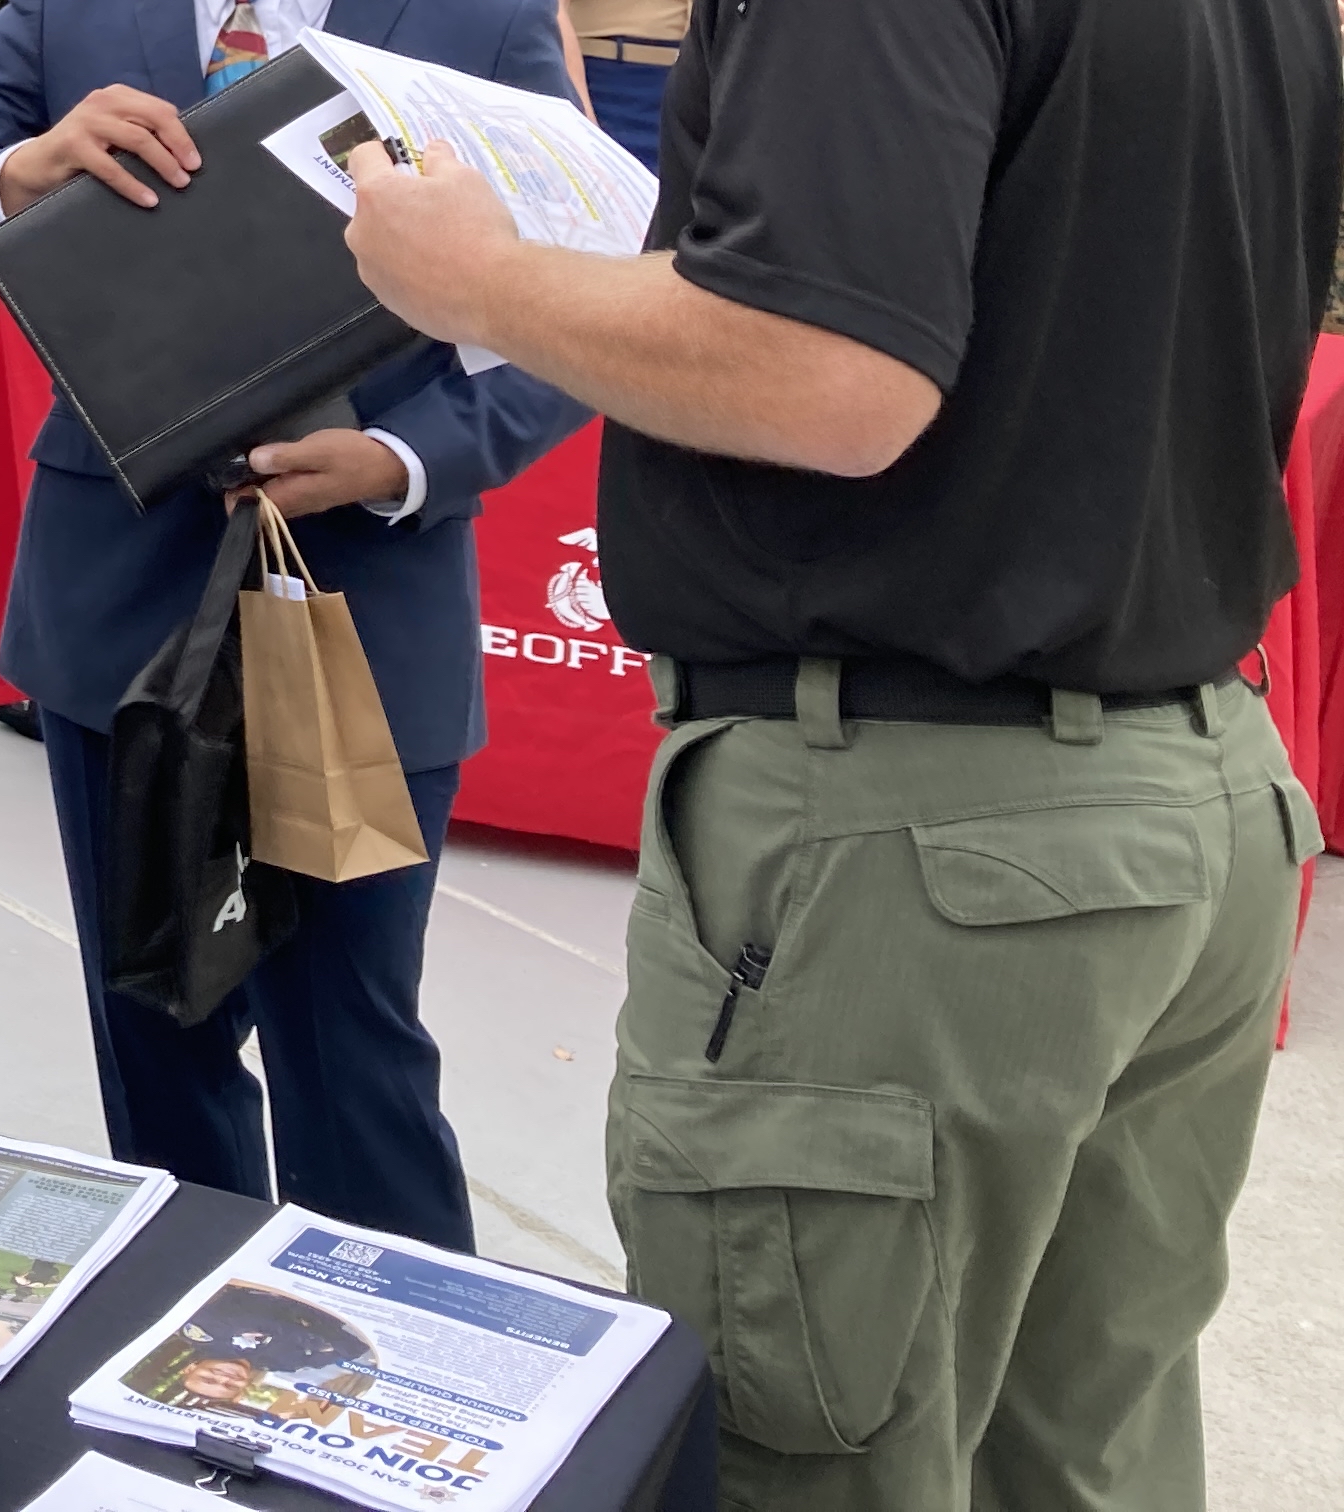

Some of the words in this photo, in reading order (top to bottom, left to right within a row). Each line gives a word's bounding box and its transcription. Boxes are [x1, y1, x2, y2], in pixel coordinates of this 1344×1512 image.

[287, 1262, 329, 1280] Now!
[331, 1276, 379, 1293] Apply
[506, 1327, 571, 1350] BENEFITS
[341, 1360, 453, 1400] QUALIFICATIONS
[123, 1395, 245, 1434] DEPARTMENT
[371, 1405, 406, 1423] PAY
[381, 1391, 453, 1420] Department
[454, 1394, 521, 1421] MINIMUM
[410, 1417, 451, 1437] STEP
[421, 1411, 442, 1424] San
[444, 1416, 468, 1430] The
[454, 1414, 490, 1429] Police
[253, 1413, 355, 1449] OUR
[266, 1391, 490, 1478] TEAM
[453, 1432, 487, 1447] TOP
[250, 1431, 315, 1456] POLICE
[363, 1445, 483, 1491] JOIN
[370, 1469, 411, 1487] SAN
